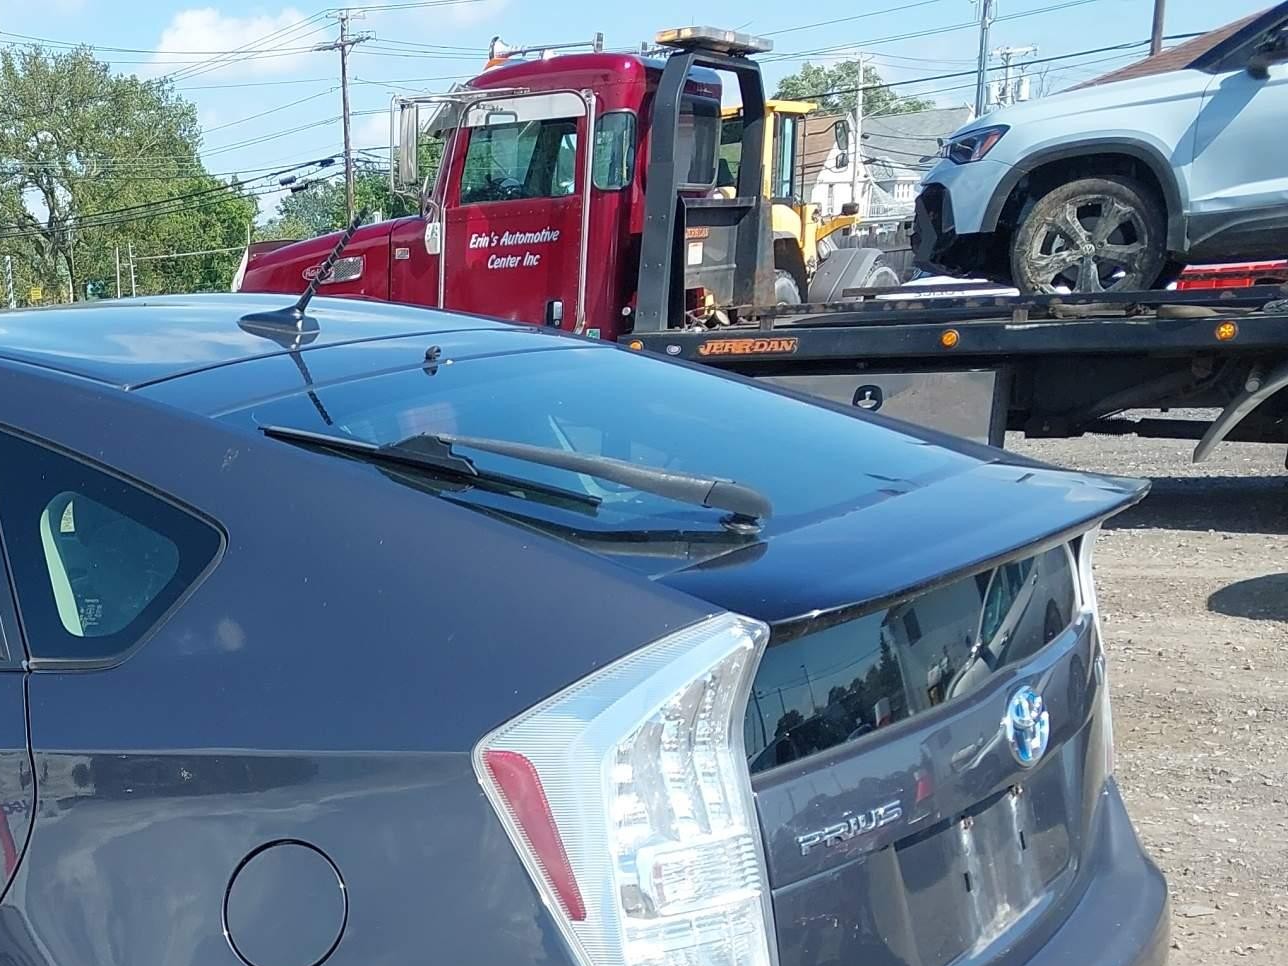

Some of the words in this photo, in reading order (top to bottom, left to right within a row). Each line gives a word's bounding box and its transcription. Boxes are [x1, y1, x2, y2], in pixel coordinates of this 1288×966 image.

[469, 231, 499, 249] Erin's
[500, 226, 560, 246] Automotive
[487, 254, 521, 269] Center
[523, 251, 541, 267] Inc
[798, 800, 903, 856] PRIUS
